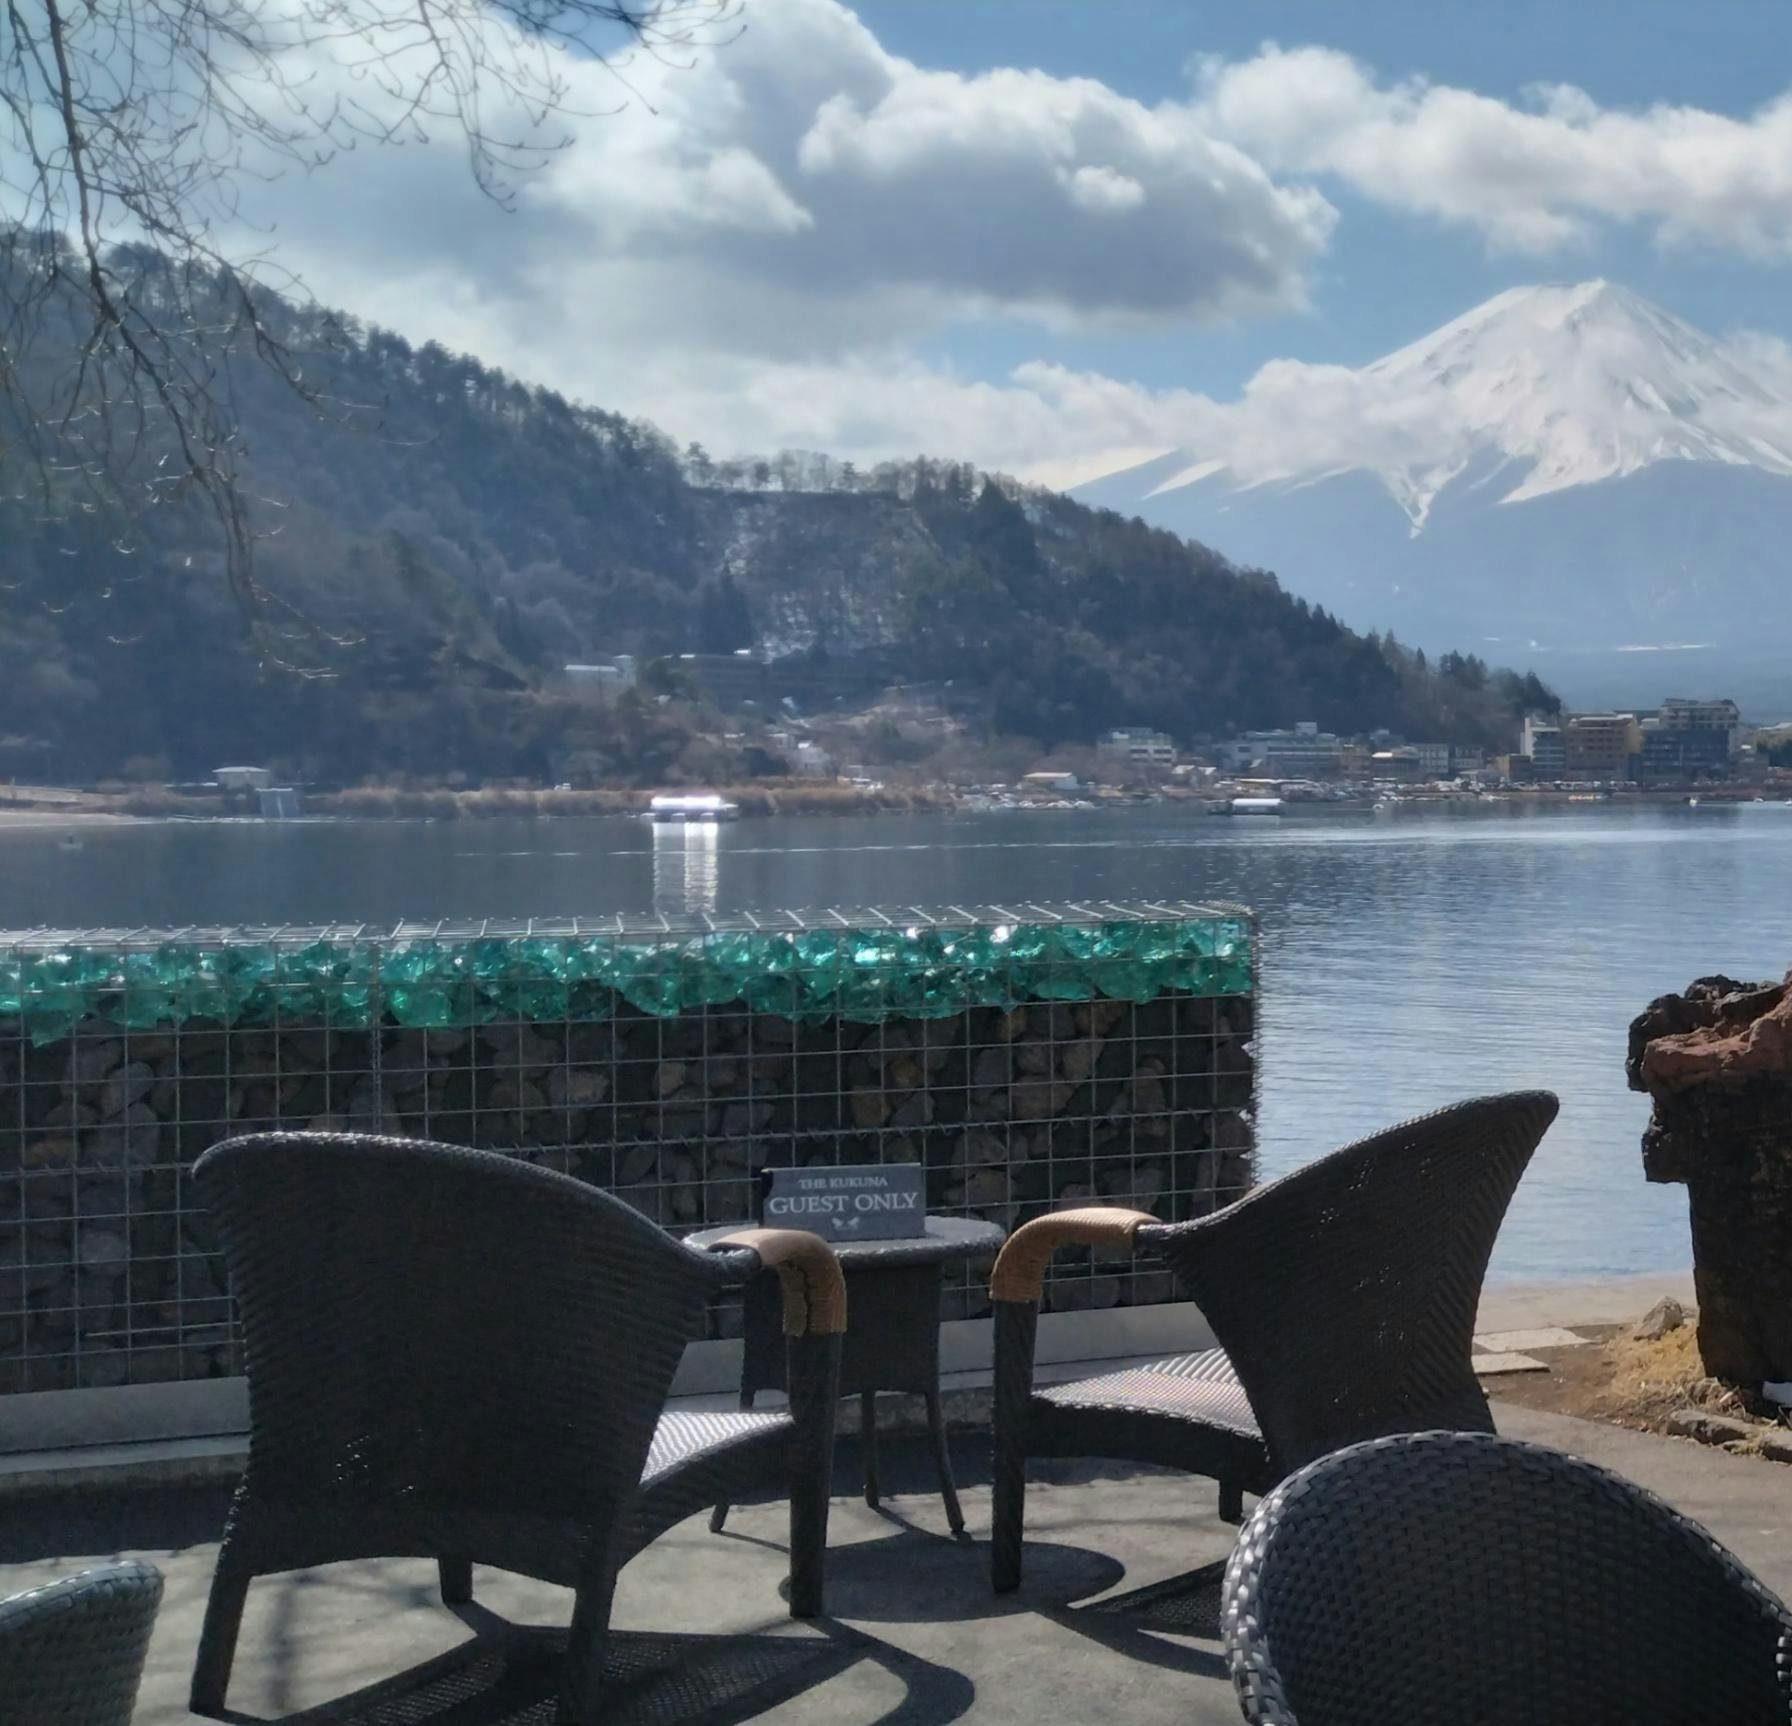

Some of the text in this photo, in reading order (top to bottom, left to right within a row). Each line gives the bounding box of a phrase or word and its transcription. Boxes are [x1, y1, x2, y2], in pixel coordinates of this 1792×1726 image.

[799, 1176, 889, 1189] THE KUKUNA
[769, 1192, 918, 1214] GUEST ONLY
